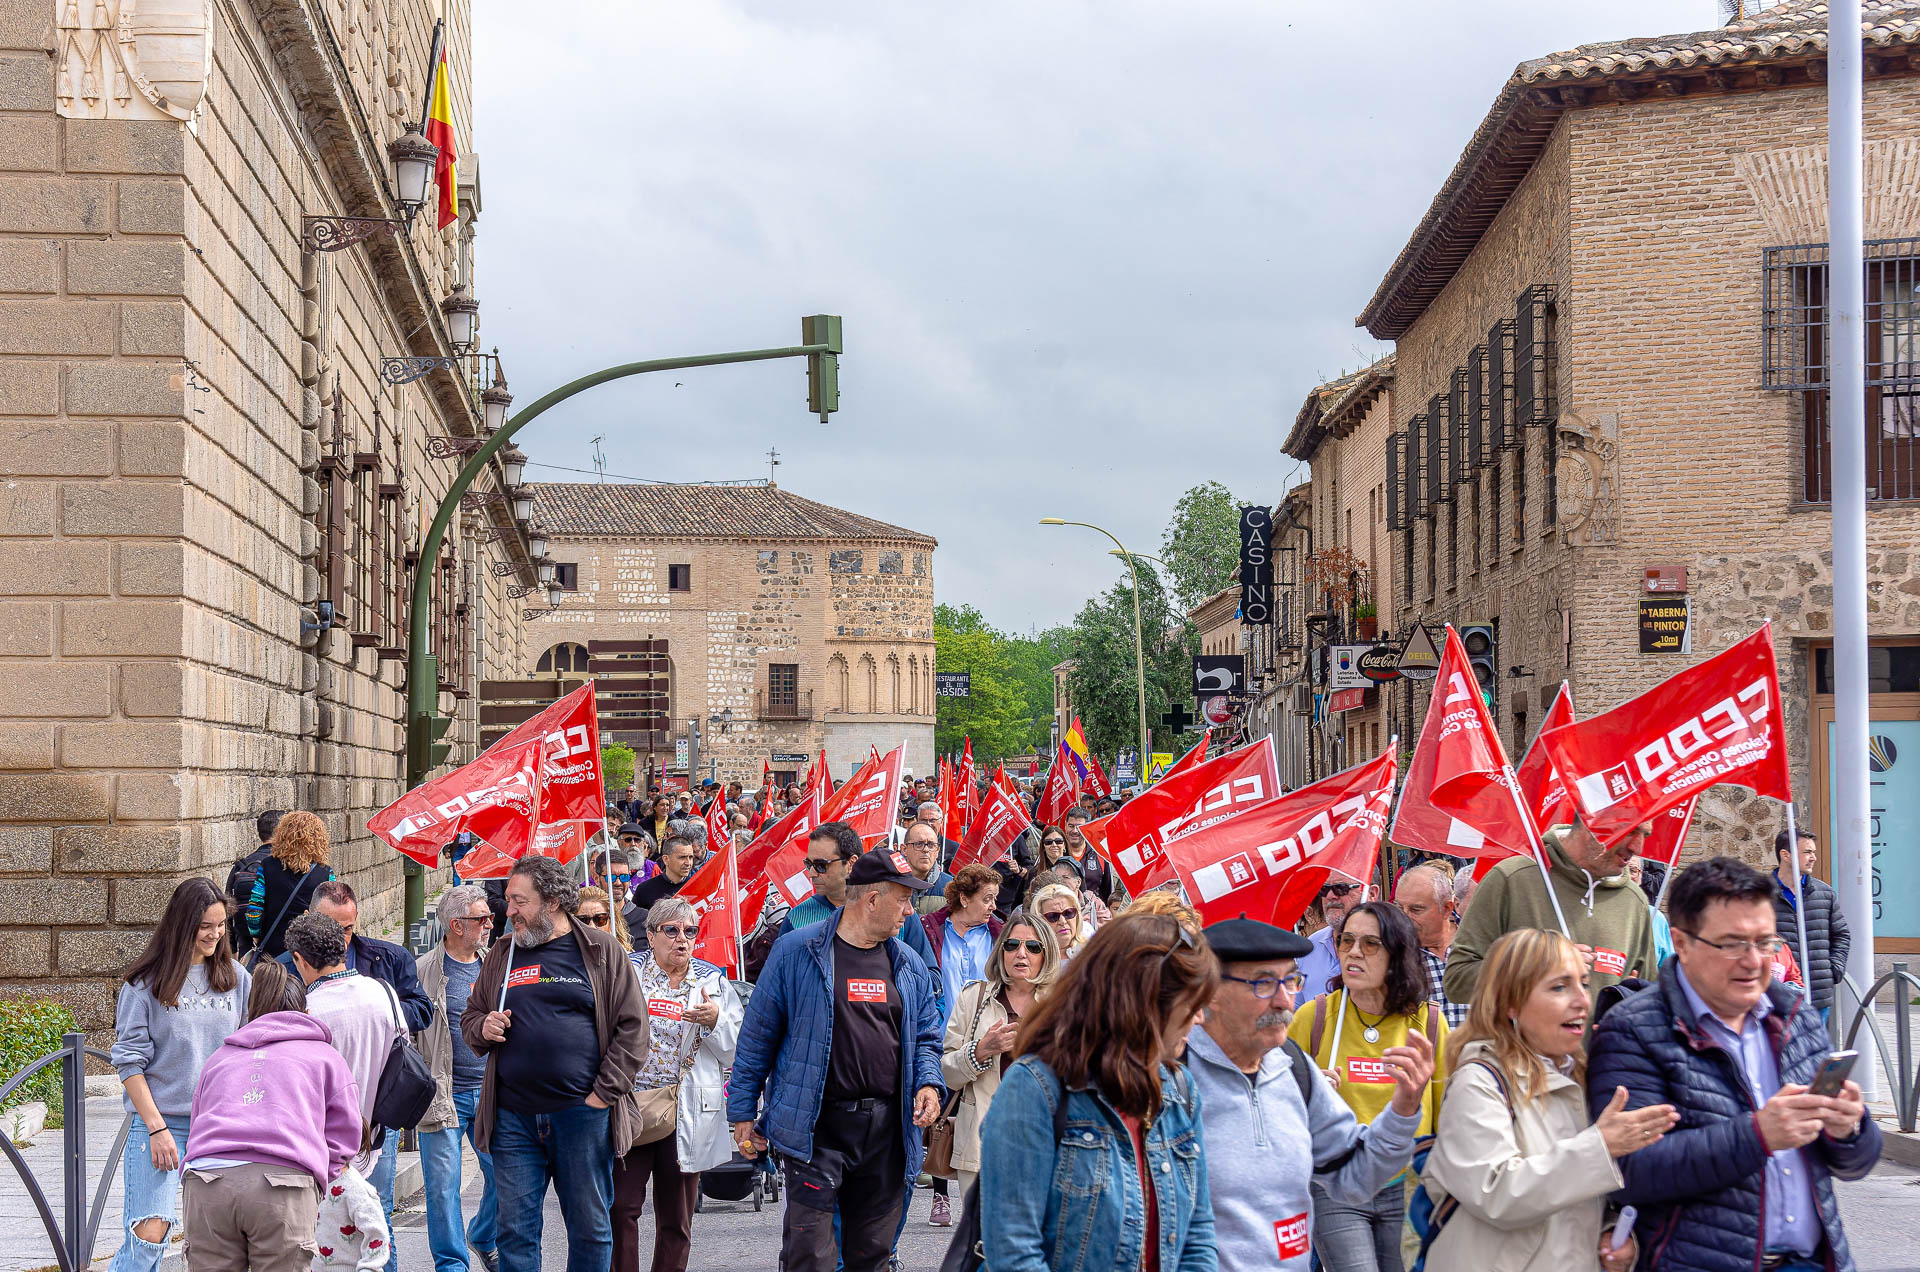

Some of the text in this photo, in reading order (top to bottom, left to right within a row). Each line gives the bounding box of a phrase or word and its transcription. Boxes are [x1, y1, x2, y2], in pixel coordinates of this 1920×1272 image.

[1246, 510, 1268, 621] CASINO
[1648, 608, 1688, 618] TABERNA
[1654, 621, 1685, 631] PINTOR
[1362, 653, 1400, 668] Coca-Col
[936, 687, 969, 697] ABSIDE
[849, 983, 885, 993] CCOO
[649, 1001, 682, 1014] CCOO
[1350, 1061, 1396, 1073] CCO
